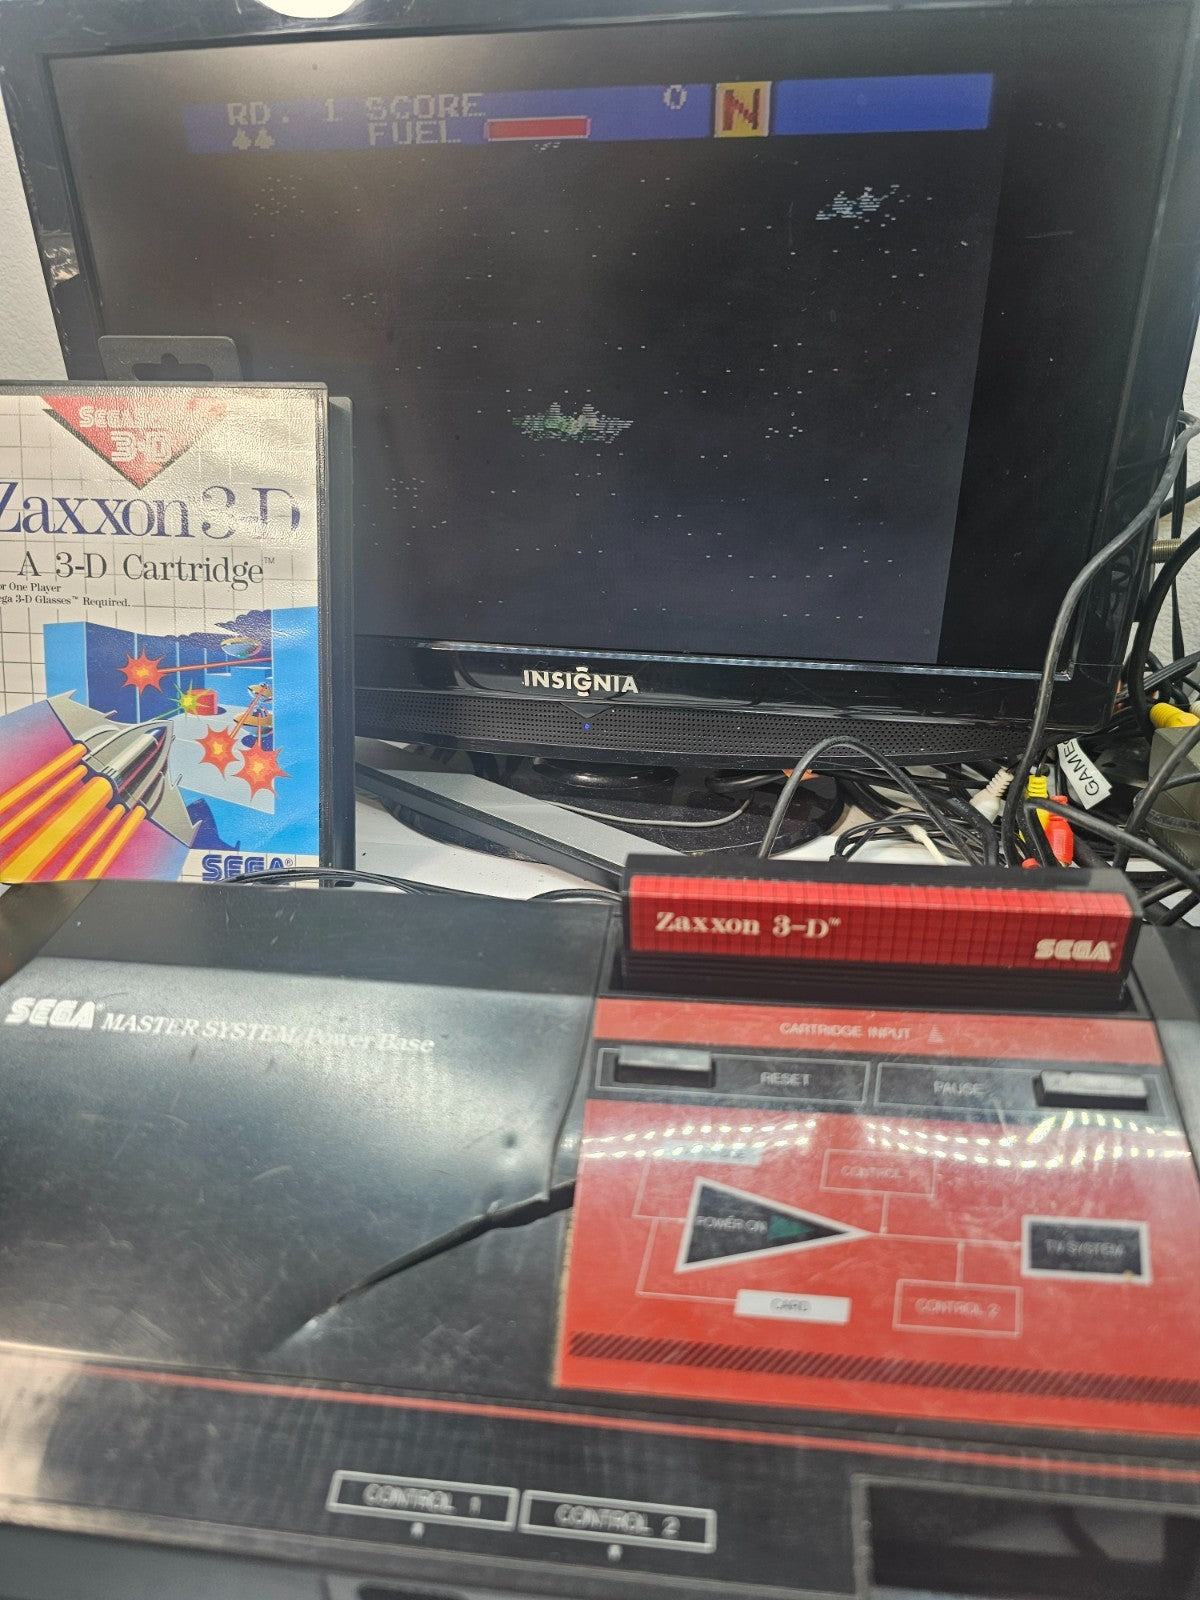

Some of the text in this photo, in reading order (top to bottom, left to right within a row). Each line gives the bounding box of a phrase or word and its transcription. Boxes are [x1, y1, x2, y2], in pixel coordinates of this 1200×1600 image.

[323, 98, 343, 122] 1
[365, 92, 486, 121] SCORE
[722, 88, 760, 131] N
[367, 119, 462, 146] FUEL
[0, 481, 195, 538] Zaxxon
[17, 551, 40, 577] A
[56, 551, 108, 578] 3-D
[9, 581, 28, 592] One
[31, 582, 62, 594] Player
[16, 594, 33, 604] 3-D
[83, 596, 131, 608] Required.
[522, 666, 639, 697] INSIGNIA
[1062, 740, 1100, 796] GAME
[655, 911, 761, 936] Zaxxon
[100, 1011, 199, 1036] MASTER
[200, 1020, 304, 1046] SYSTEM
[779, 1022, 912, 1040] CARTRIDGE INPUT
[760, 1071, 811, 1087] RESET
[933, 1080, 984, 1096] PAUSE
[661, 1515, 681, 1539] 2
